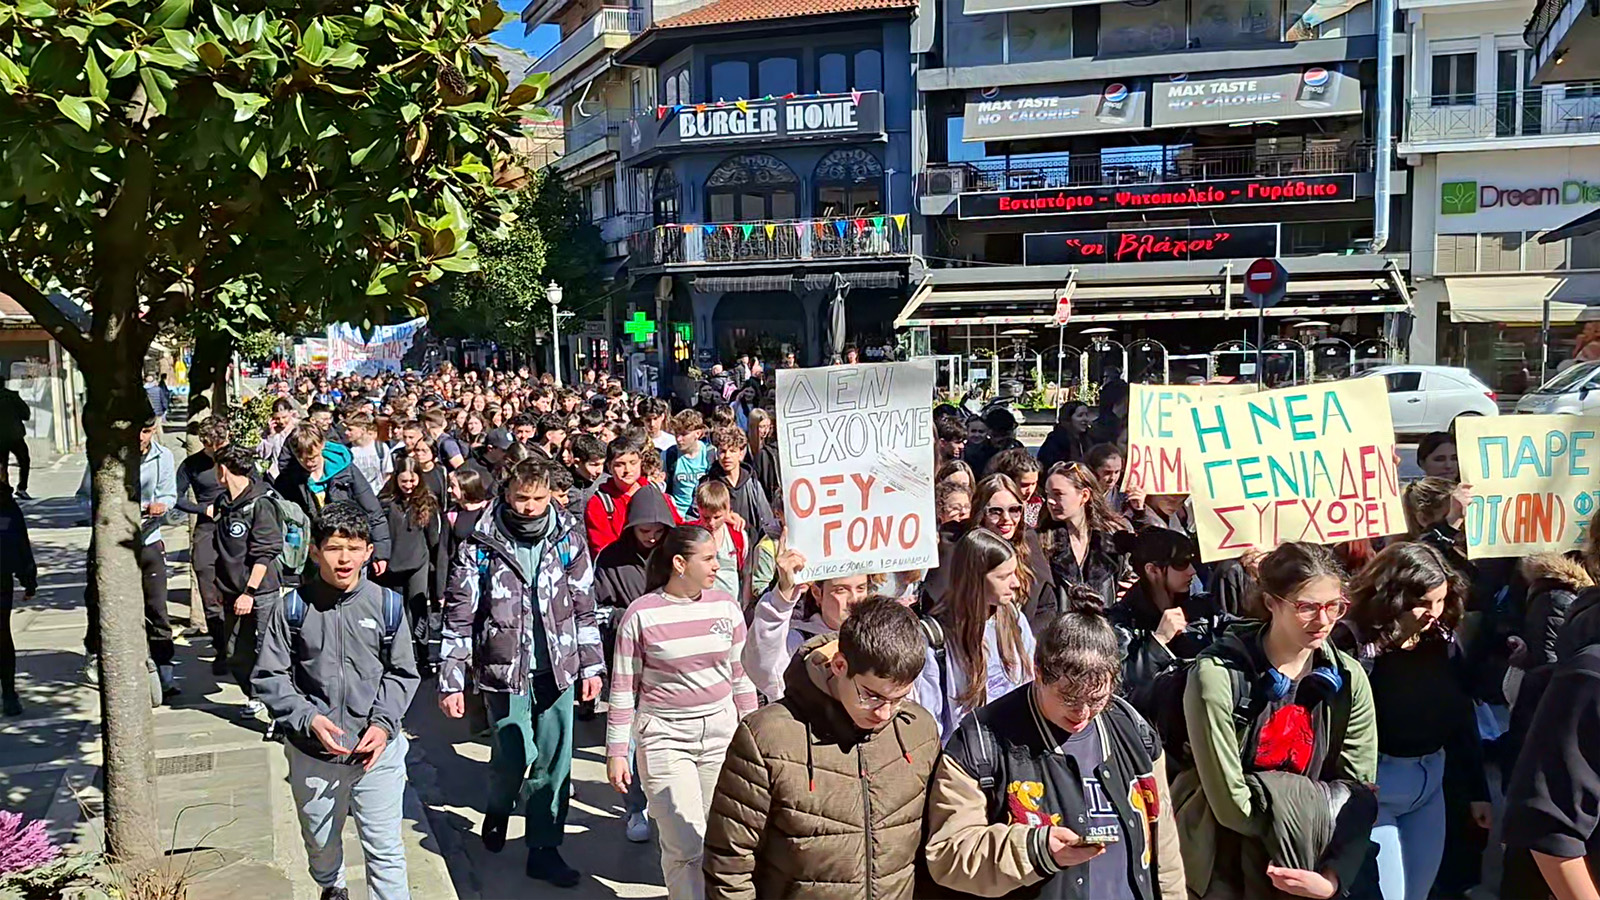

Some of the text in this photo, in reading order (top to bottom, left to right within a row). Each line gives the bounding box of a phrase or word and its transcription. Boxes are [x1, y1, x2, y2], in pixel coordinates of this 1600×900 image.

[978, 96, 1059, 112] MAX TASTE
[1168, 81, 1257, 97] MAX TASTE
[1202, 91, 1282, 108] CALORIES
[680, 102, 859, 138] BURGER HOME
[978, 107, 1080, 125] NO CALORIES
[1000, 192, 1093, 211] Εστιατόριο
[1115, 186, 1225, 206] Ψητοπωλείο
[1247, 181, 1338, 200] Γυράδικο
[783, 366, 894, 419] ΔΕΝ
[786, 406, 931, 468] ΕΧΟΥΜΕ
[1190, 390, 1353, 454] Η ΝΕΑ
[1126, 444, 1190, 493] ΒΑΜ
[1203, 443, 1399, 502] ΓΕΝΙΑ ΔΕΝ
[1477, 429, 1595, 480] ΠΑΡΕ
[822, 512, 921, 557] ΓΟΝΟ
[1212, 499, 1390, 550] ΣΥΓΧΩΡΕΙ
[1090, 824, 1119, 836] RSITY
